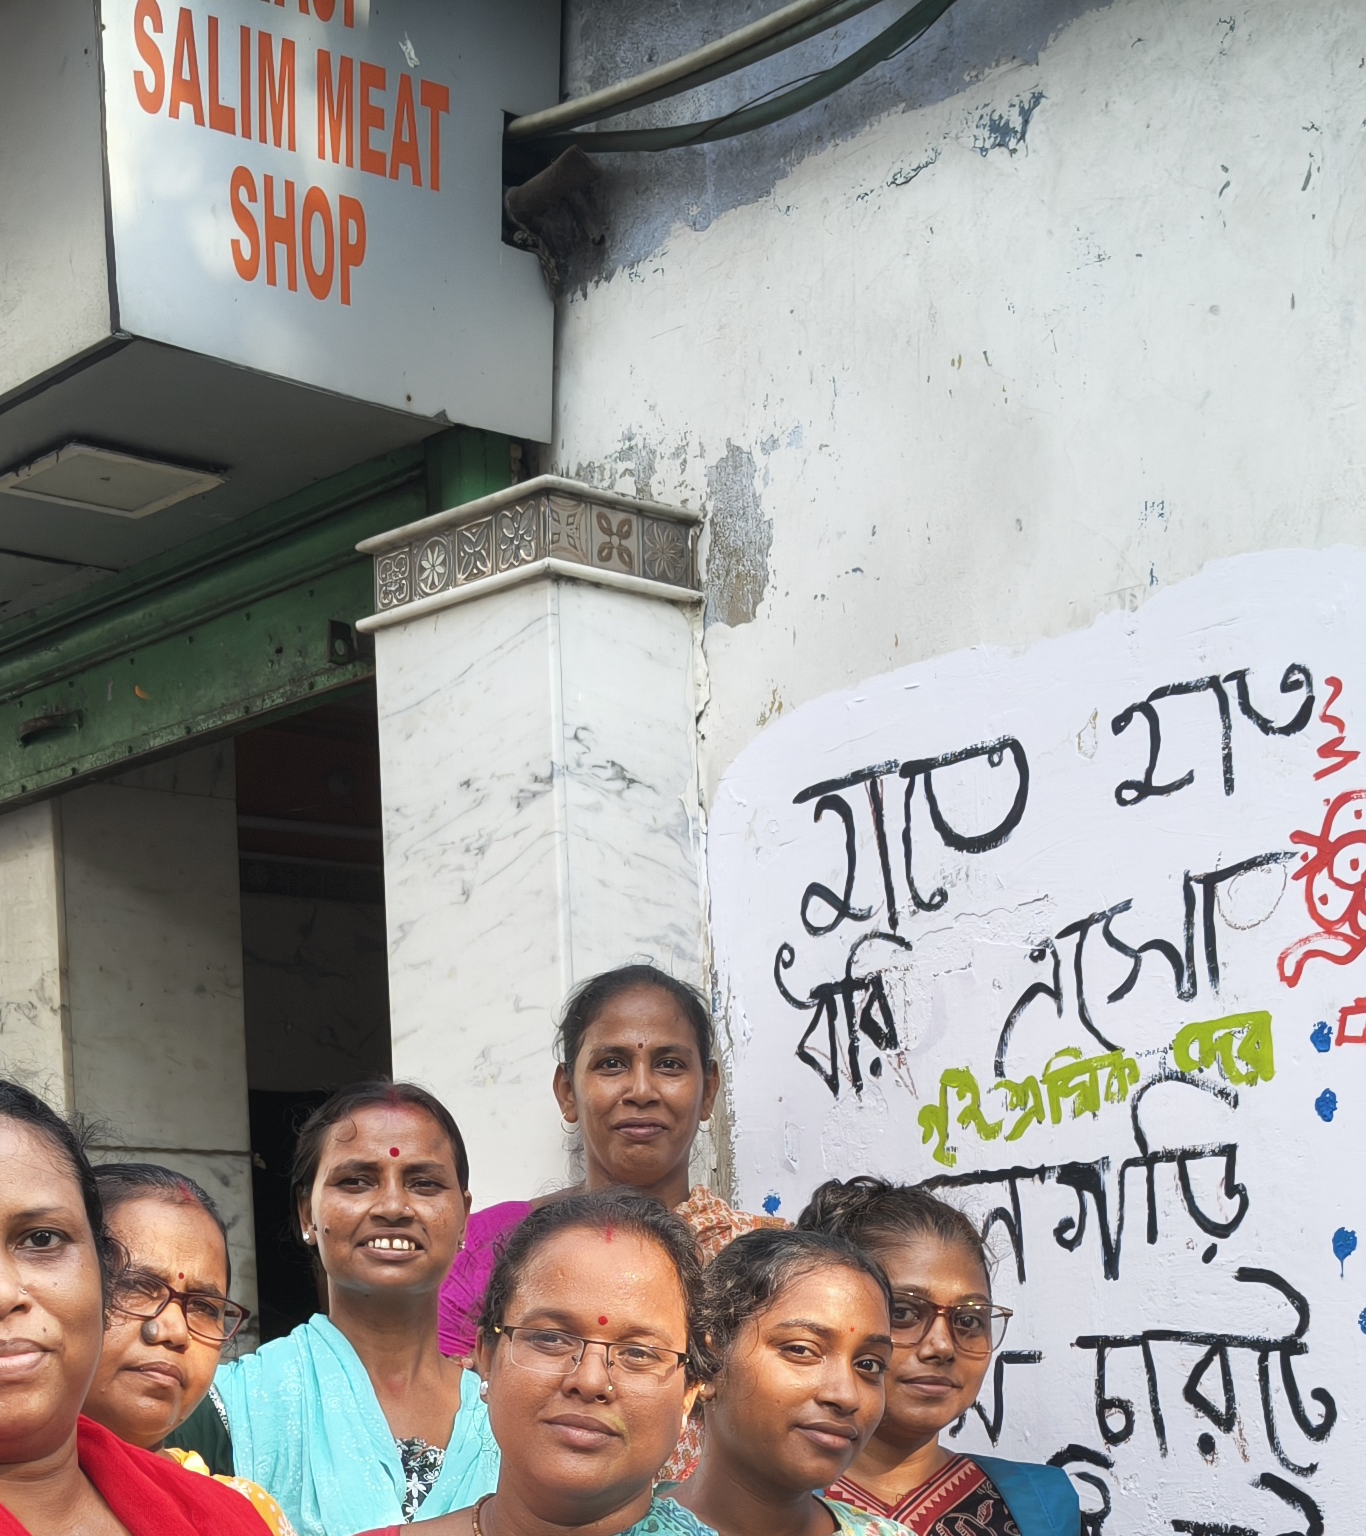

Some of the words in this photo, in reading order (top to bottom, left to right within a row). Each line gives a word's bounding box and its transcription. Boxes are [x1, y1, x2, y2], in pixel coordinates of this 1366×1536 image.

[133, 0, 297, 151] SALIM
[316, 48, 450, 192] MEAT
[229, 165, 367, 306] SHOP
[792, 735, 1031, 936] হাতে
[1110, 661, 1316, 808] হাত
